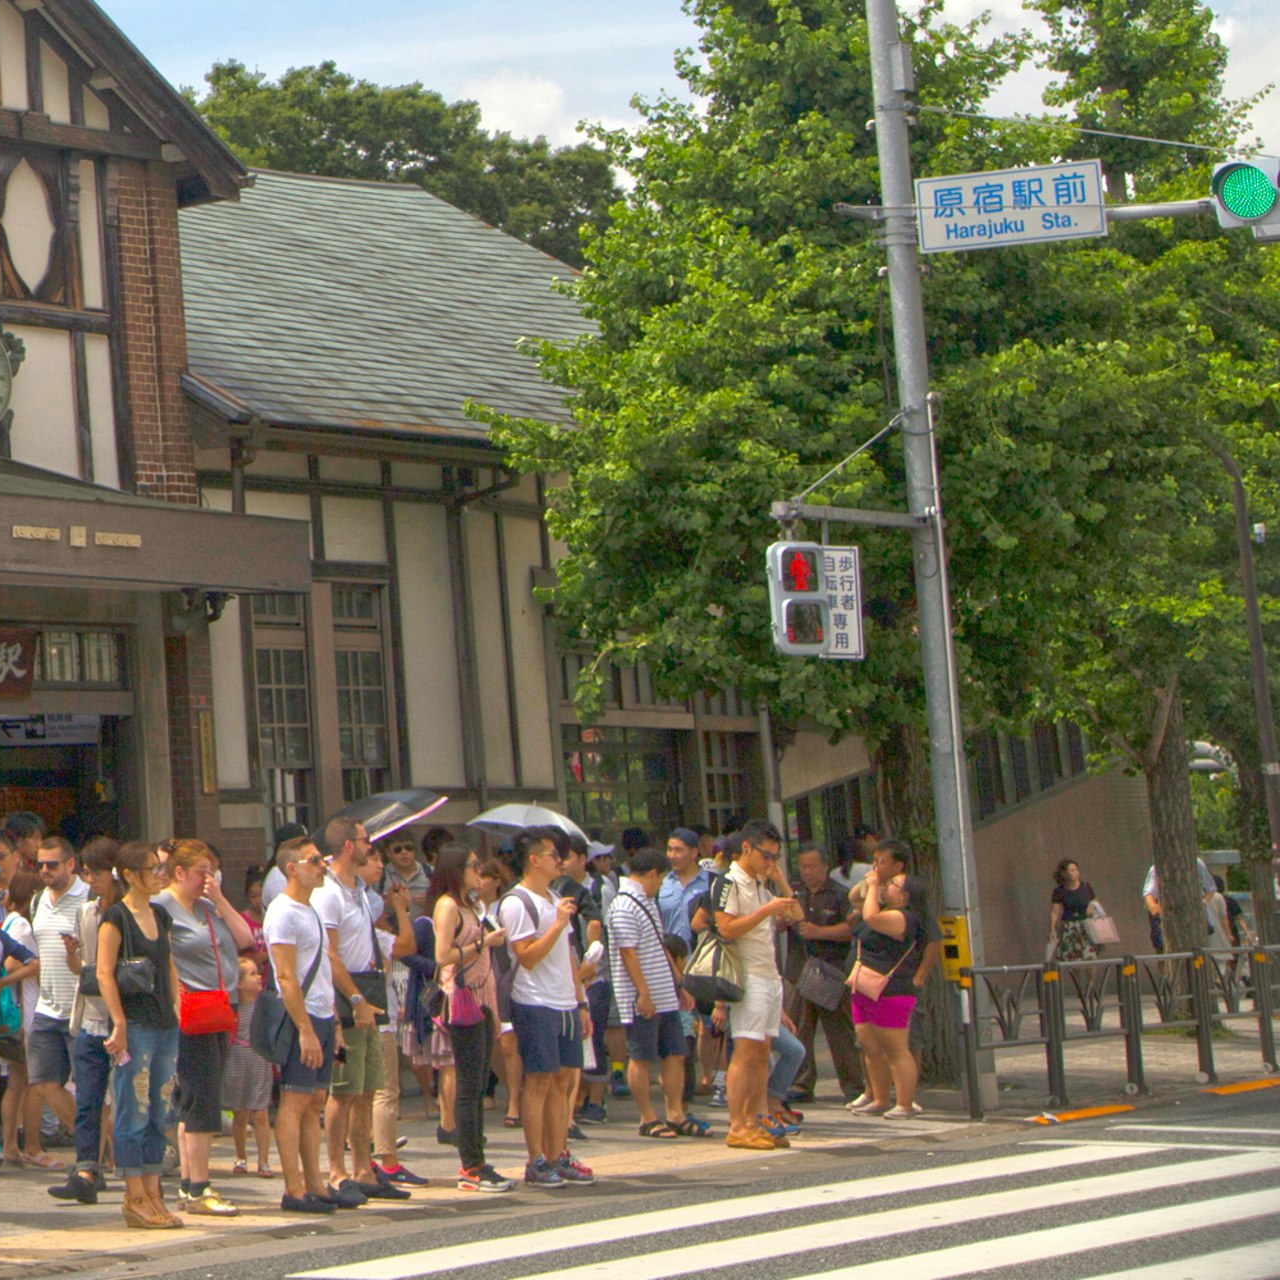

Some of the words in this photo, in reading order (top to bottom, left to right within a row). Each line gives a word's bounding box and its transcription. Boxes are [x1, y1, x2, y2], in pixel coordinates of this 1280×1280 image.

[933, 172, 1086, 218] 原宿駅前
[945, 218, 1024, 240] Harajuku
[1042, 213, 1078, 230] Sta.
[839, 555, 855, 610] 歩行者
[833, 613, 849, 649] 専用
